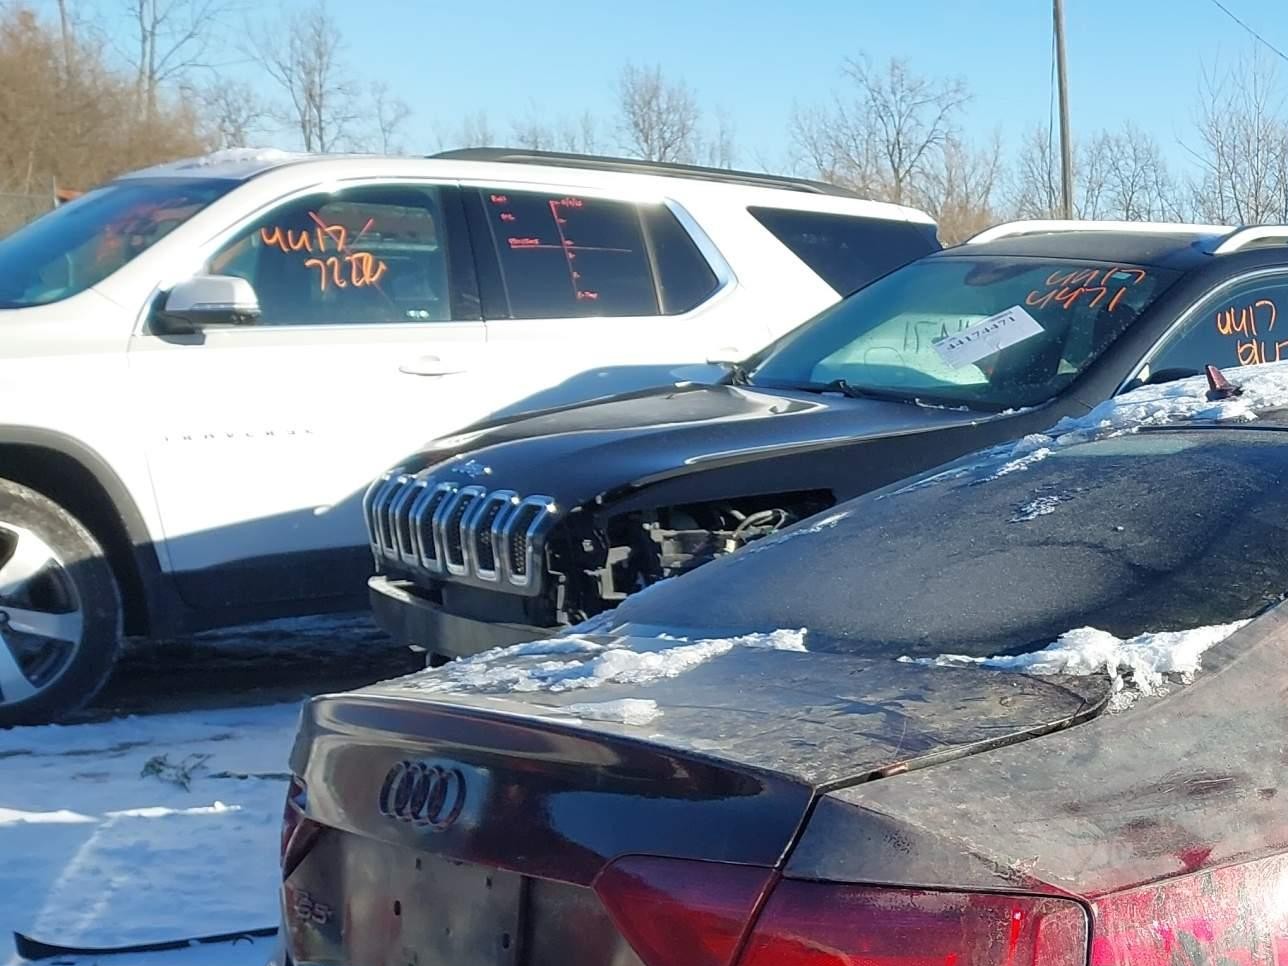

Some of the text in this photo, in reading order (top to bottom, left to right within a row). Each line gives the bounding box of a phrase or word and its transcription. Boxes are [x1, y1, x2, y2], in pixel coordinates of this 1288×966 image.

[260, 225, 346, 253] 4417
[1045, 267, 1147, 288] 4417
[1025, 286, 1127, 312] 4471
[1216, 299, 1277, 338] 4417
[946, 316, 1017, 351] 44174471
